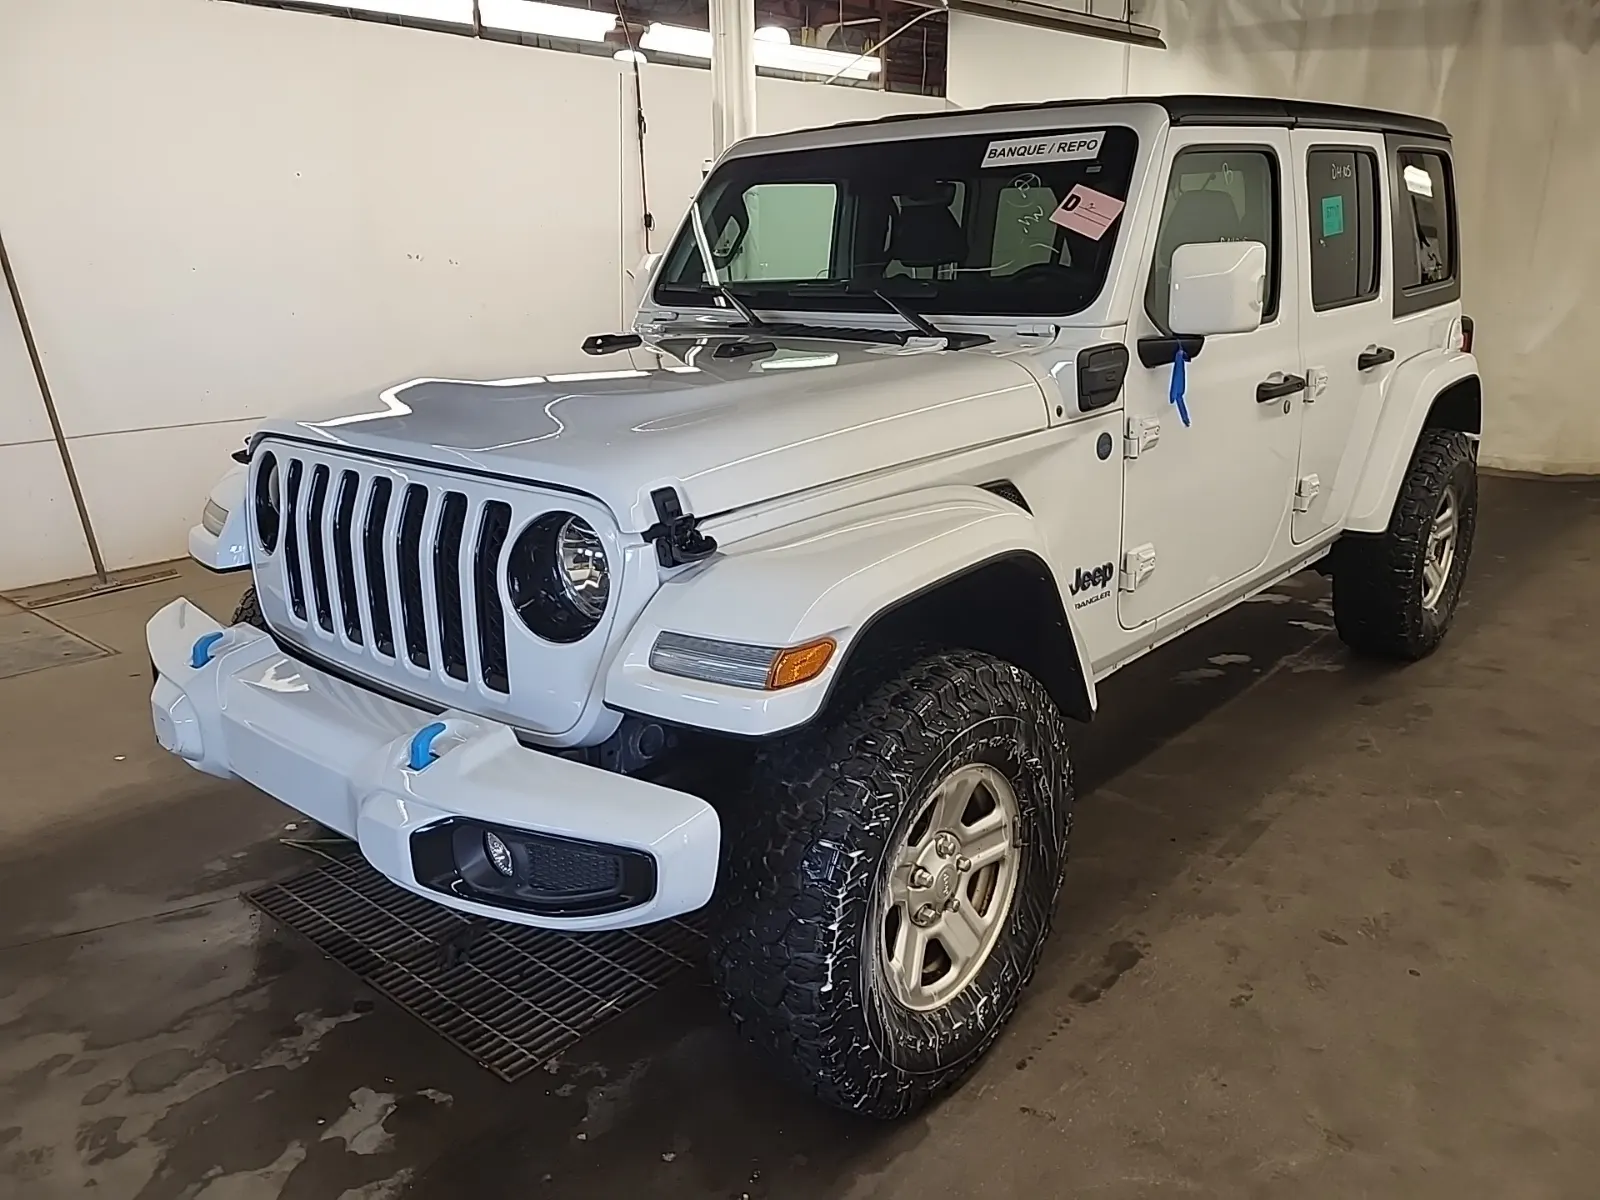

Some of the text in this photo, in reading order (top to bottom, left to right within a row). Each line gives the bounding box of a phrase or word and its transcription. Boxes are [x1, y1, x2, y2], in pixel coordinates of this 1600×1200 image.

[987, 139, 1098, 159] BANQUE / REPO
[1061, 193, 1081, 212] D
[1068, 562, 1113, 596] Jeep
